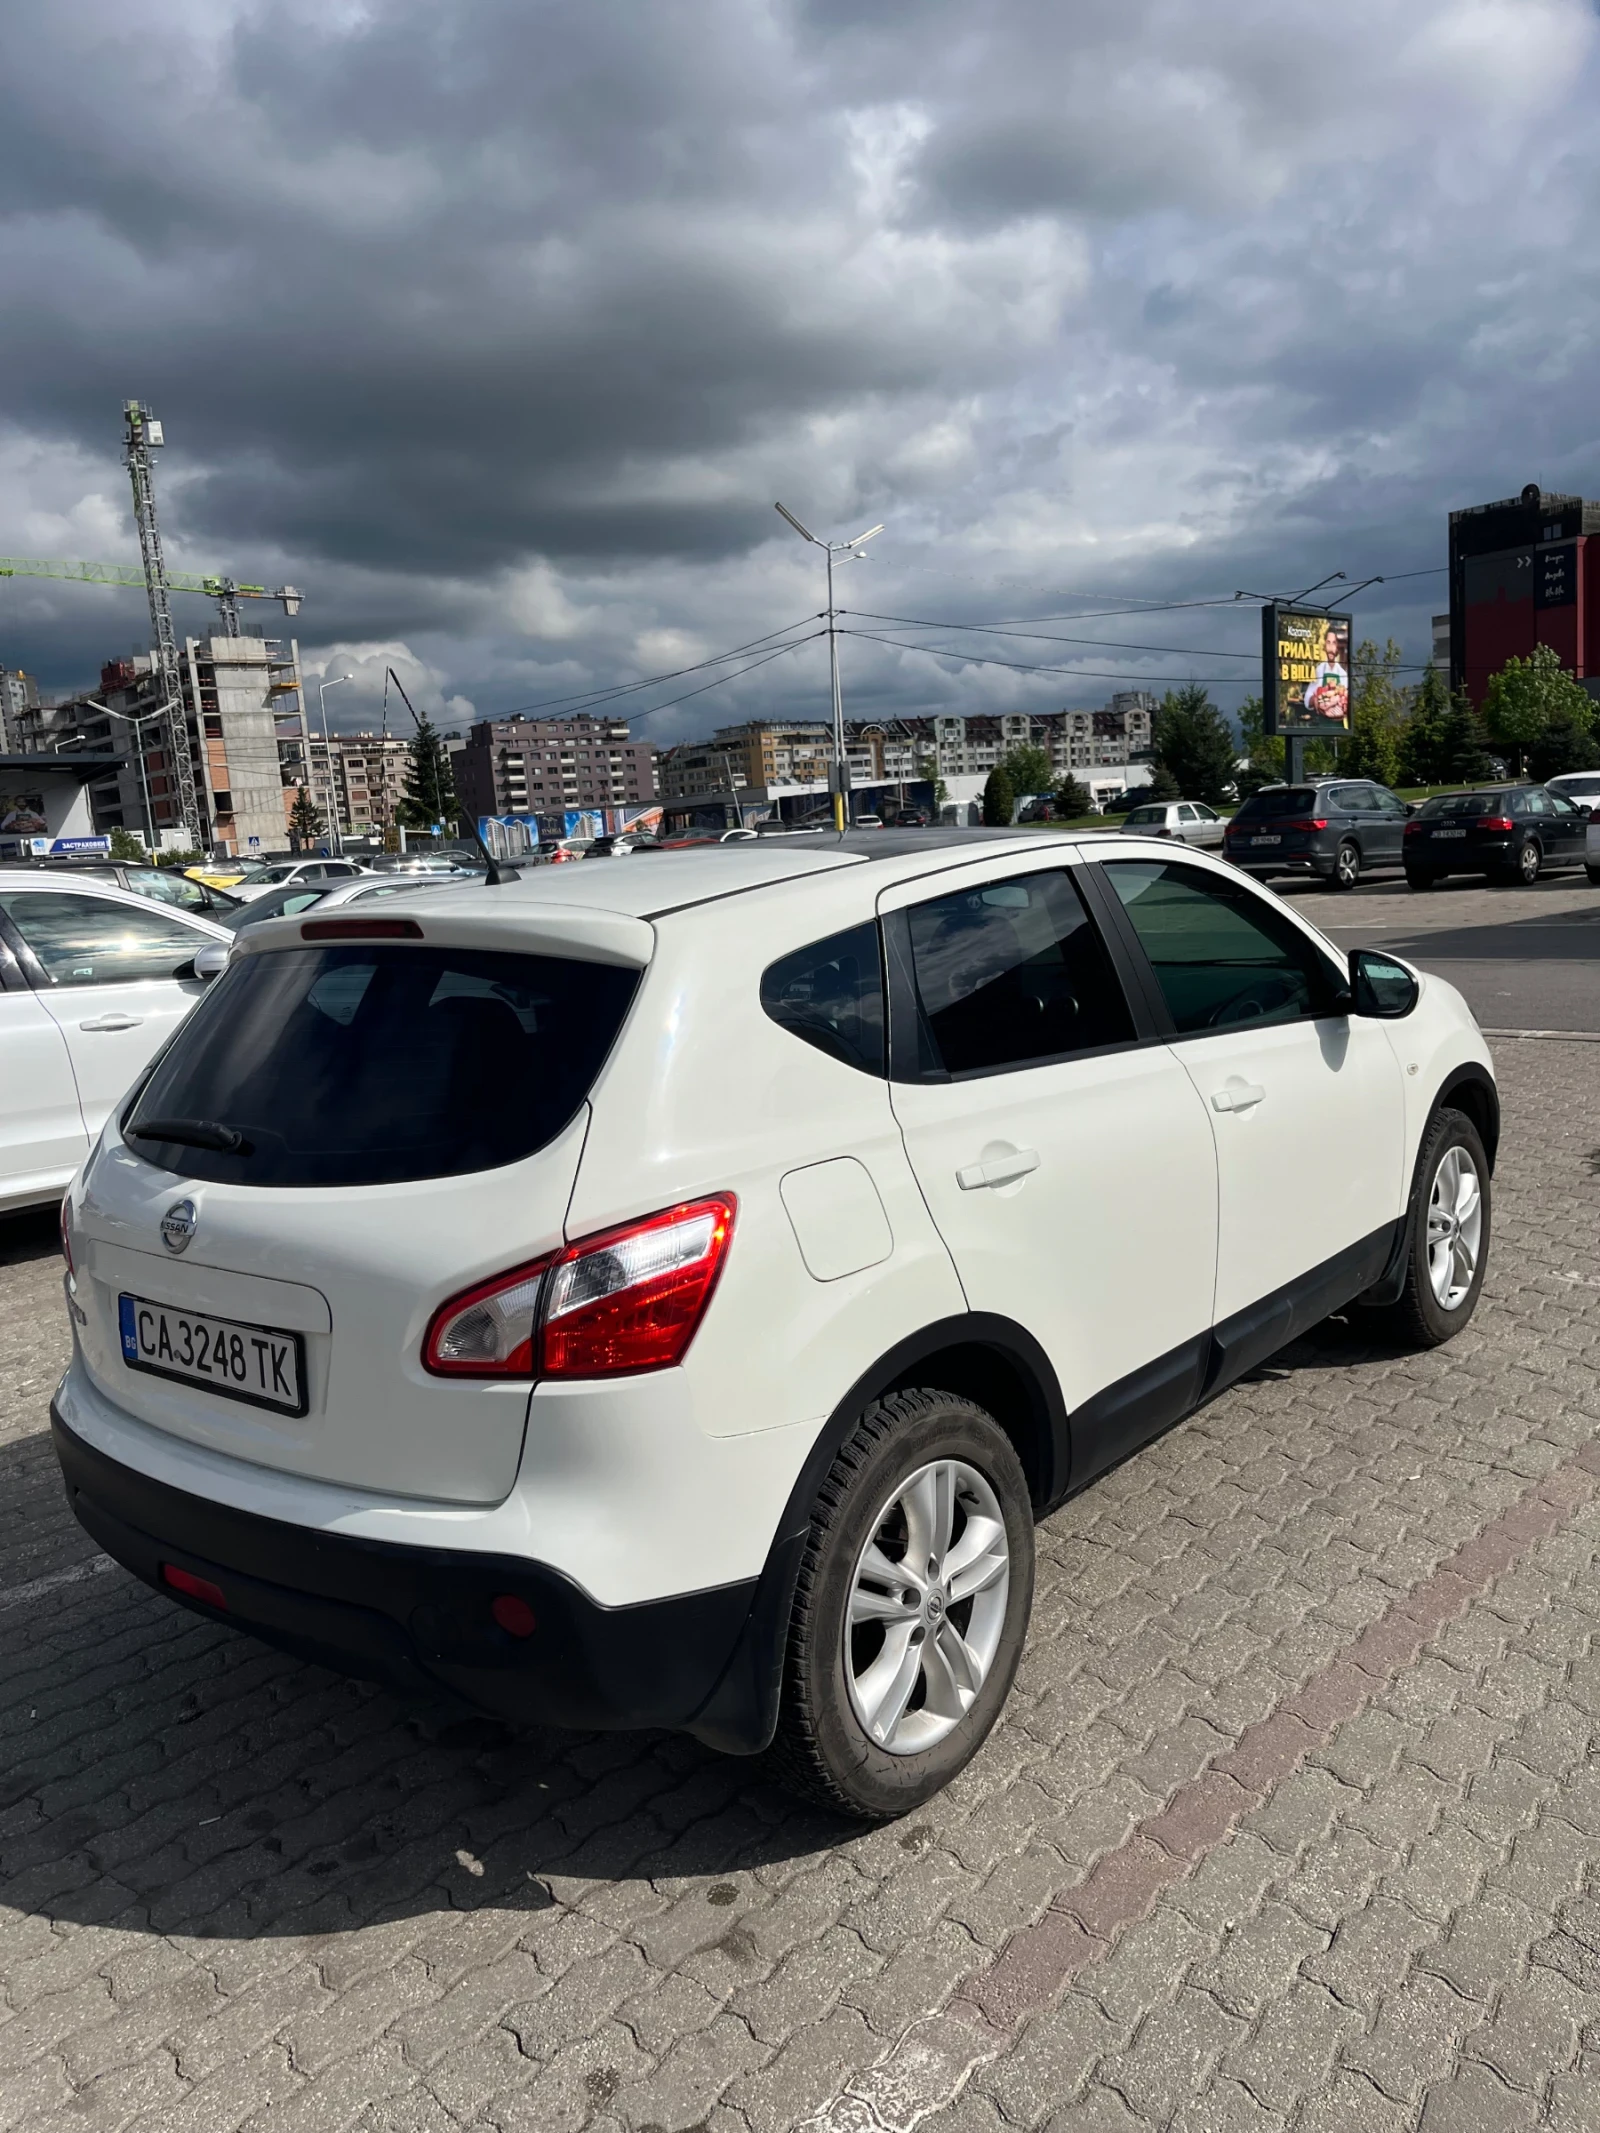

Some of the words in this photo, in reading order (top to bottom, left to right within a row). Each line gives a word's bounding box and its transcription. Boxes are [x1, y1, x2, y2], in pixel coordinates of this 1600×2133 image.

[1278, 640, 1312, 660] ГРИЛА
[1281, 664, 1289, 680] В
[1291, 664, 1316, 683] BILLA
[62, 840, 105, 849] ЗАСТРАХОВКИ
[125, 1335, 137, 1350] BG
